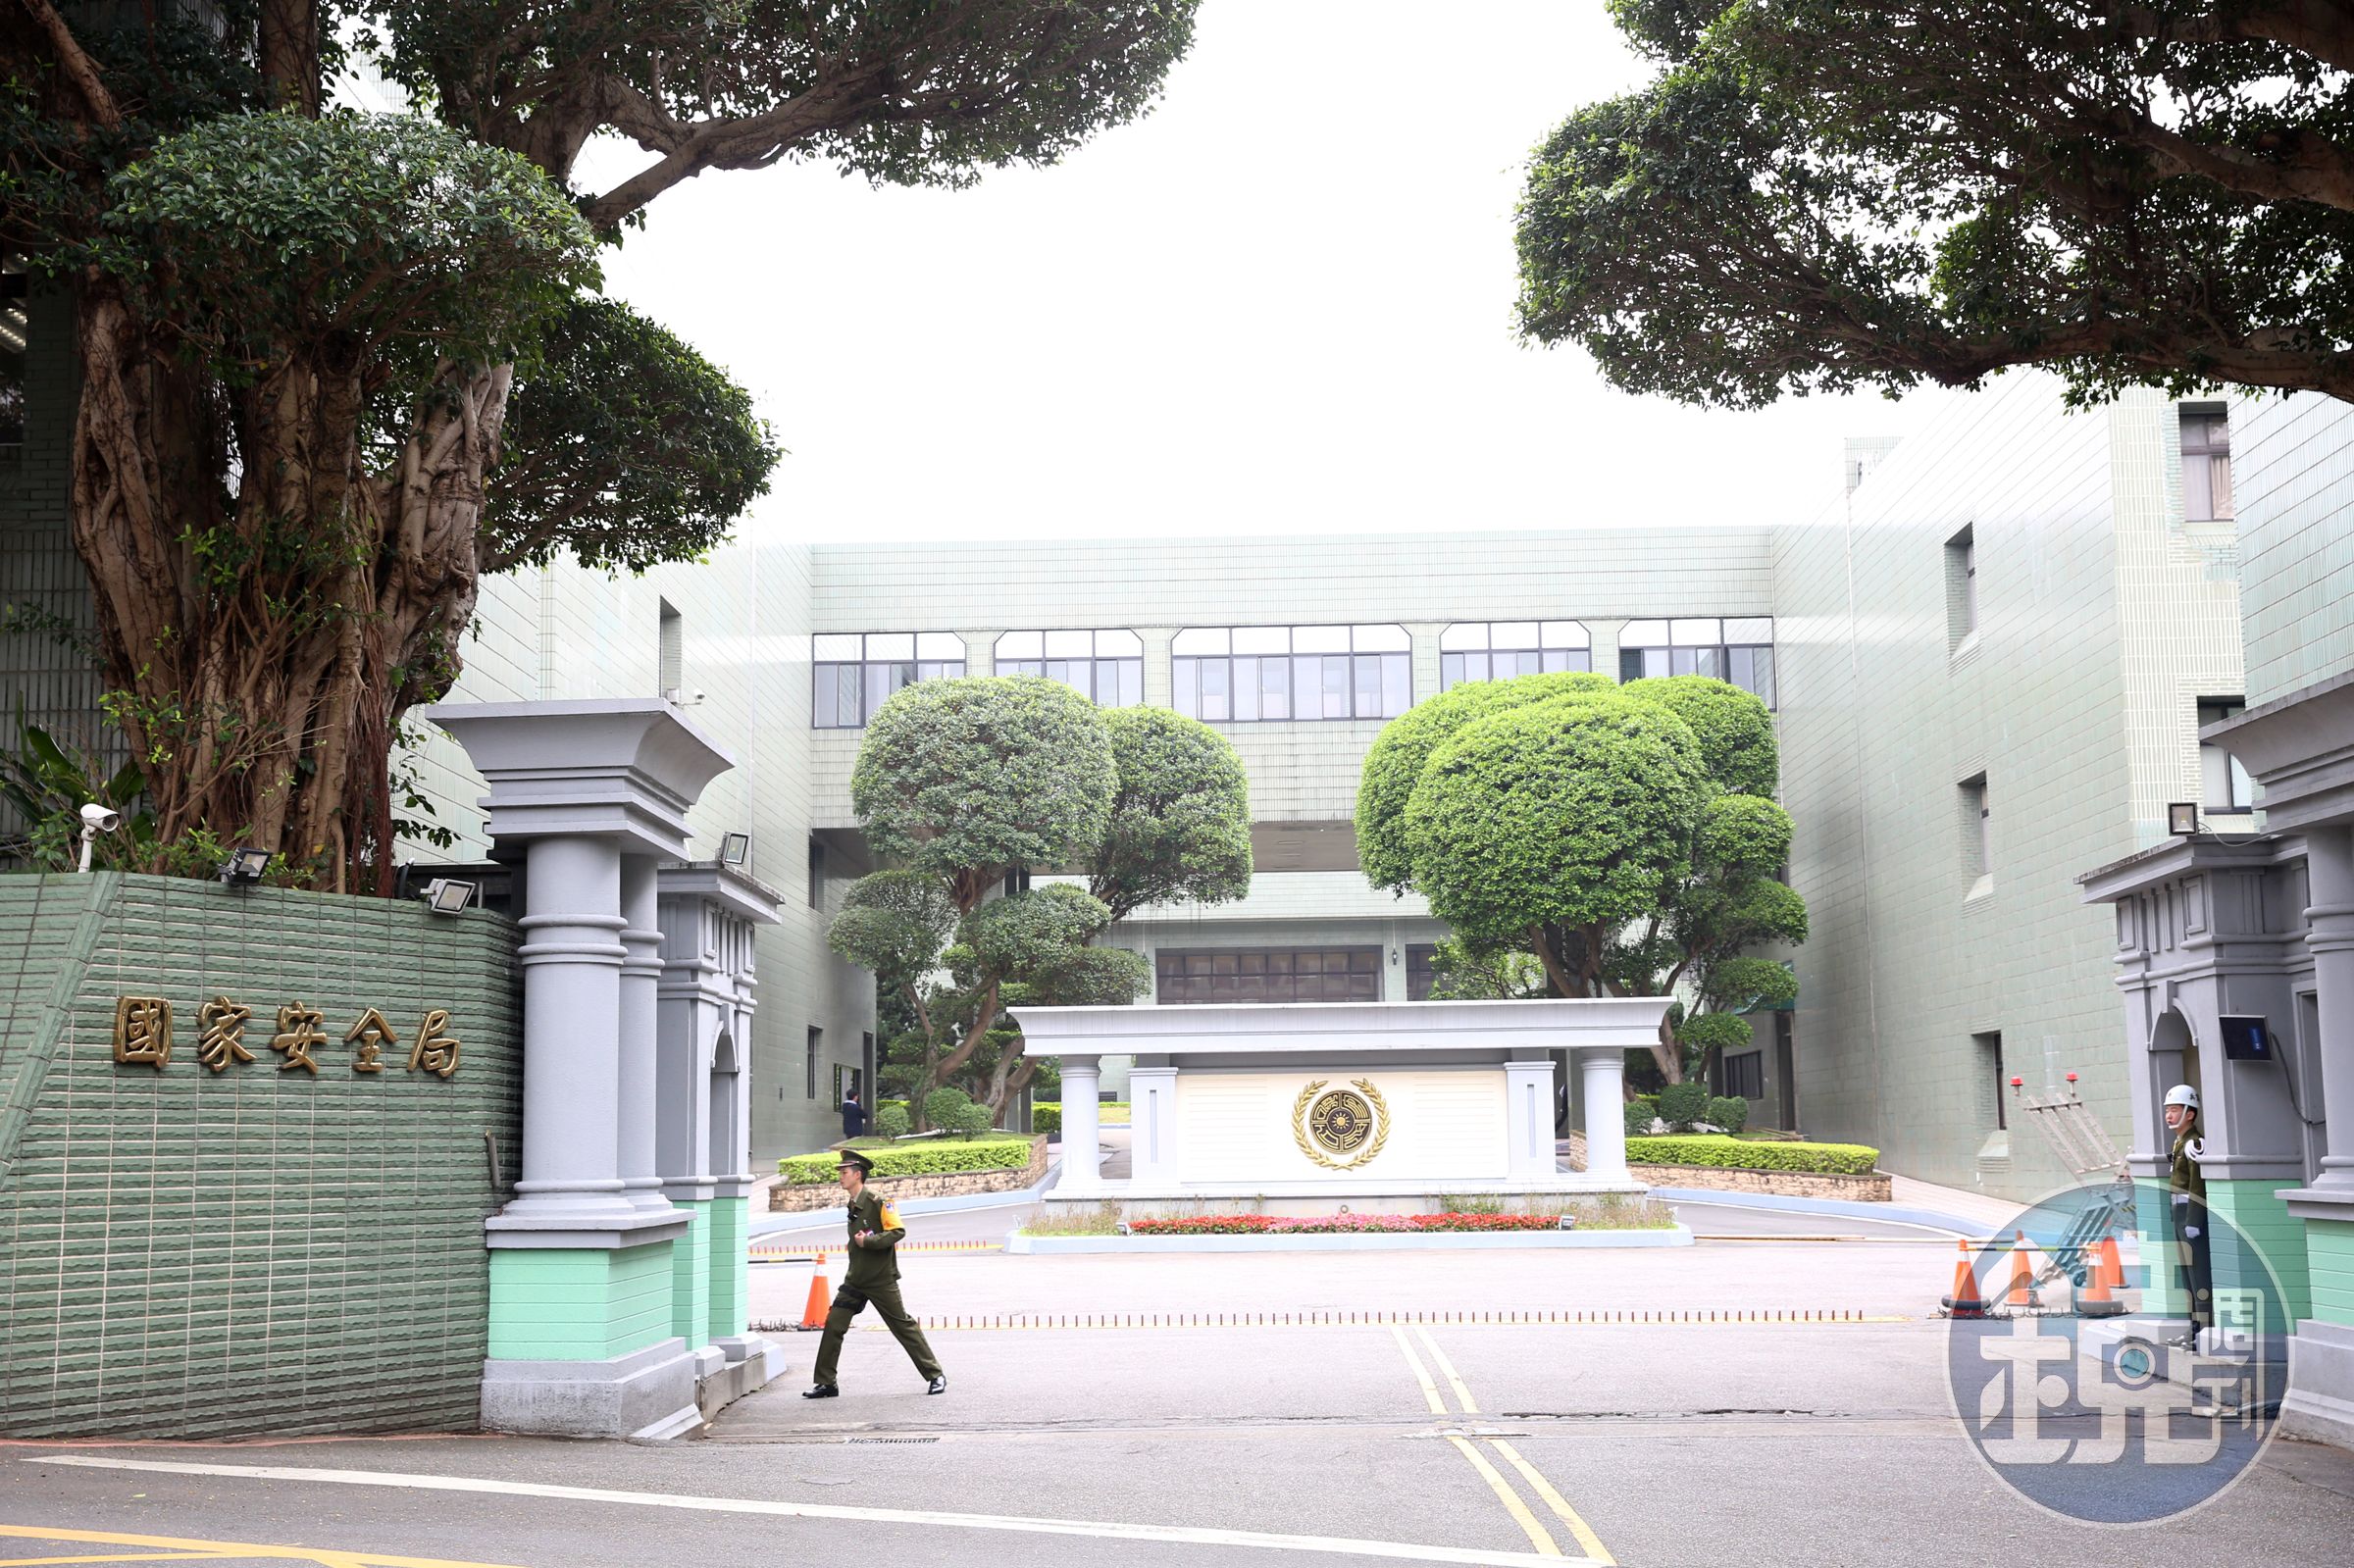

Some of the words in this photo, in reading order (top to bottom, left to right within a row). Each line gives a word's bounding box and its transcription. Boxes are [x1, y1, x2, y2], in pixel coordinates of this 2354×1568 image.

[113, 994, 461, 1078] 國家安全局
